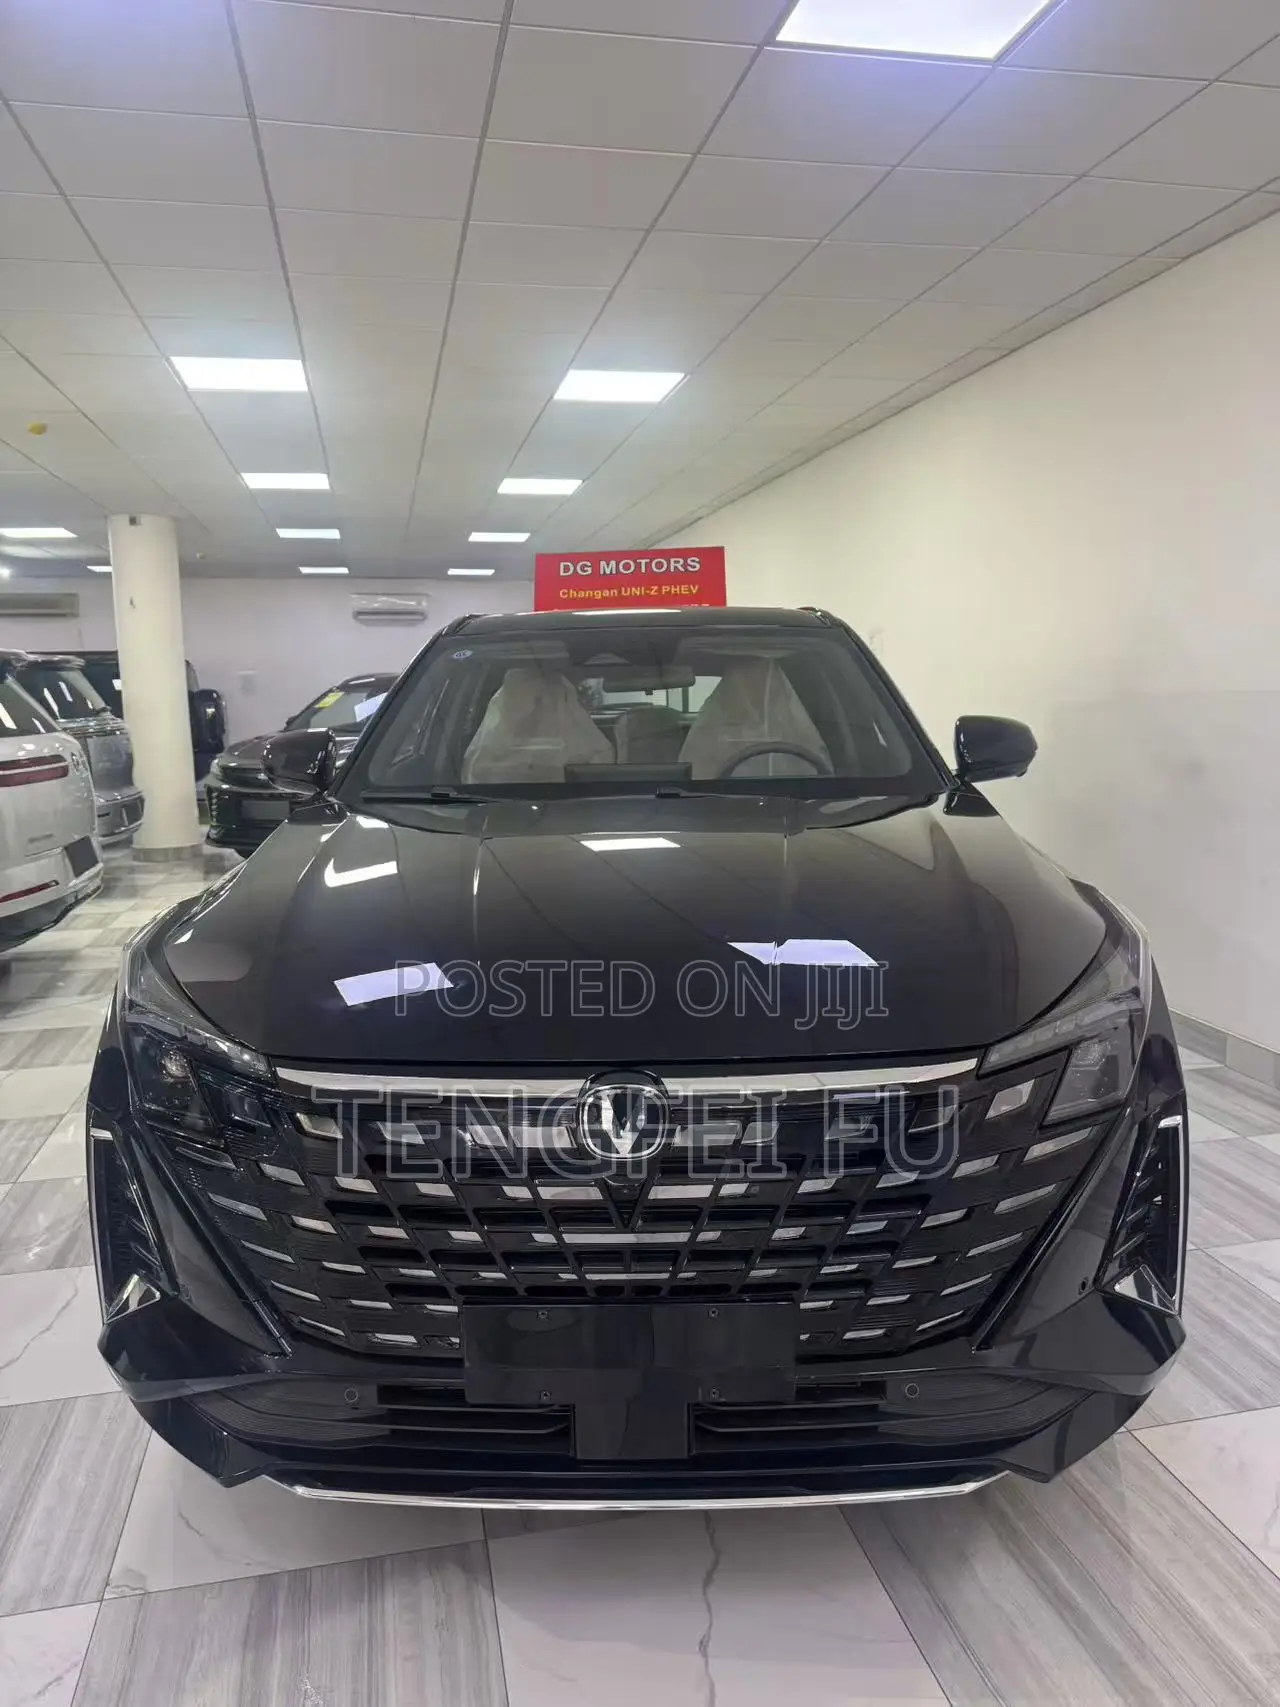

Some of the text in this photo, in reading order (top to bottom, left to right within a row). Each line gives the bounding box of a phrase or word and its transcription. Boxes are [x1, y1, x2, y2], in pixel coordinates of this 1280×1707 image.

[559, 557, 701, 576] DG MOTORS
[559, 584, 699, 600] Changan UNI-Z PHEV
